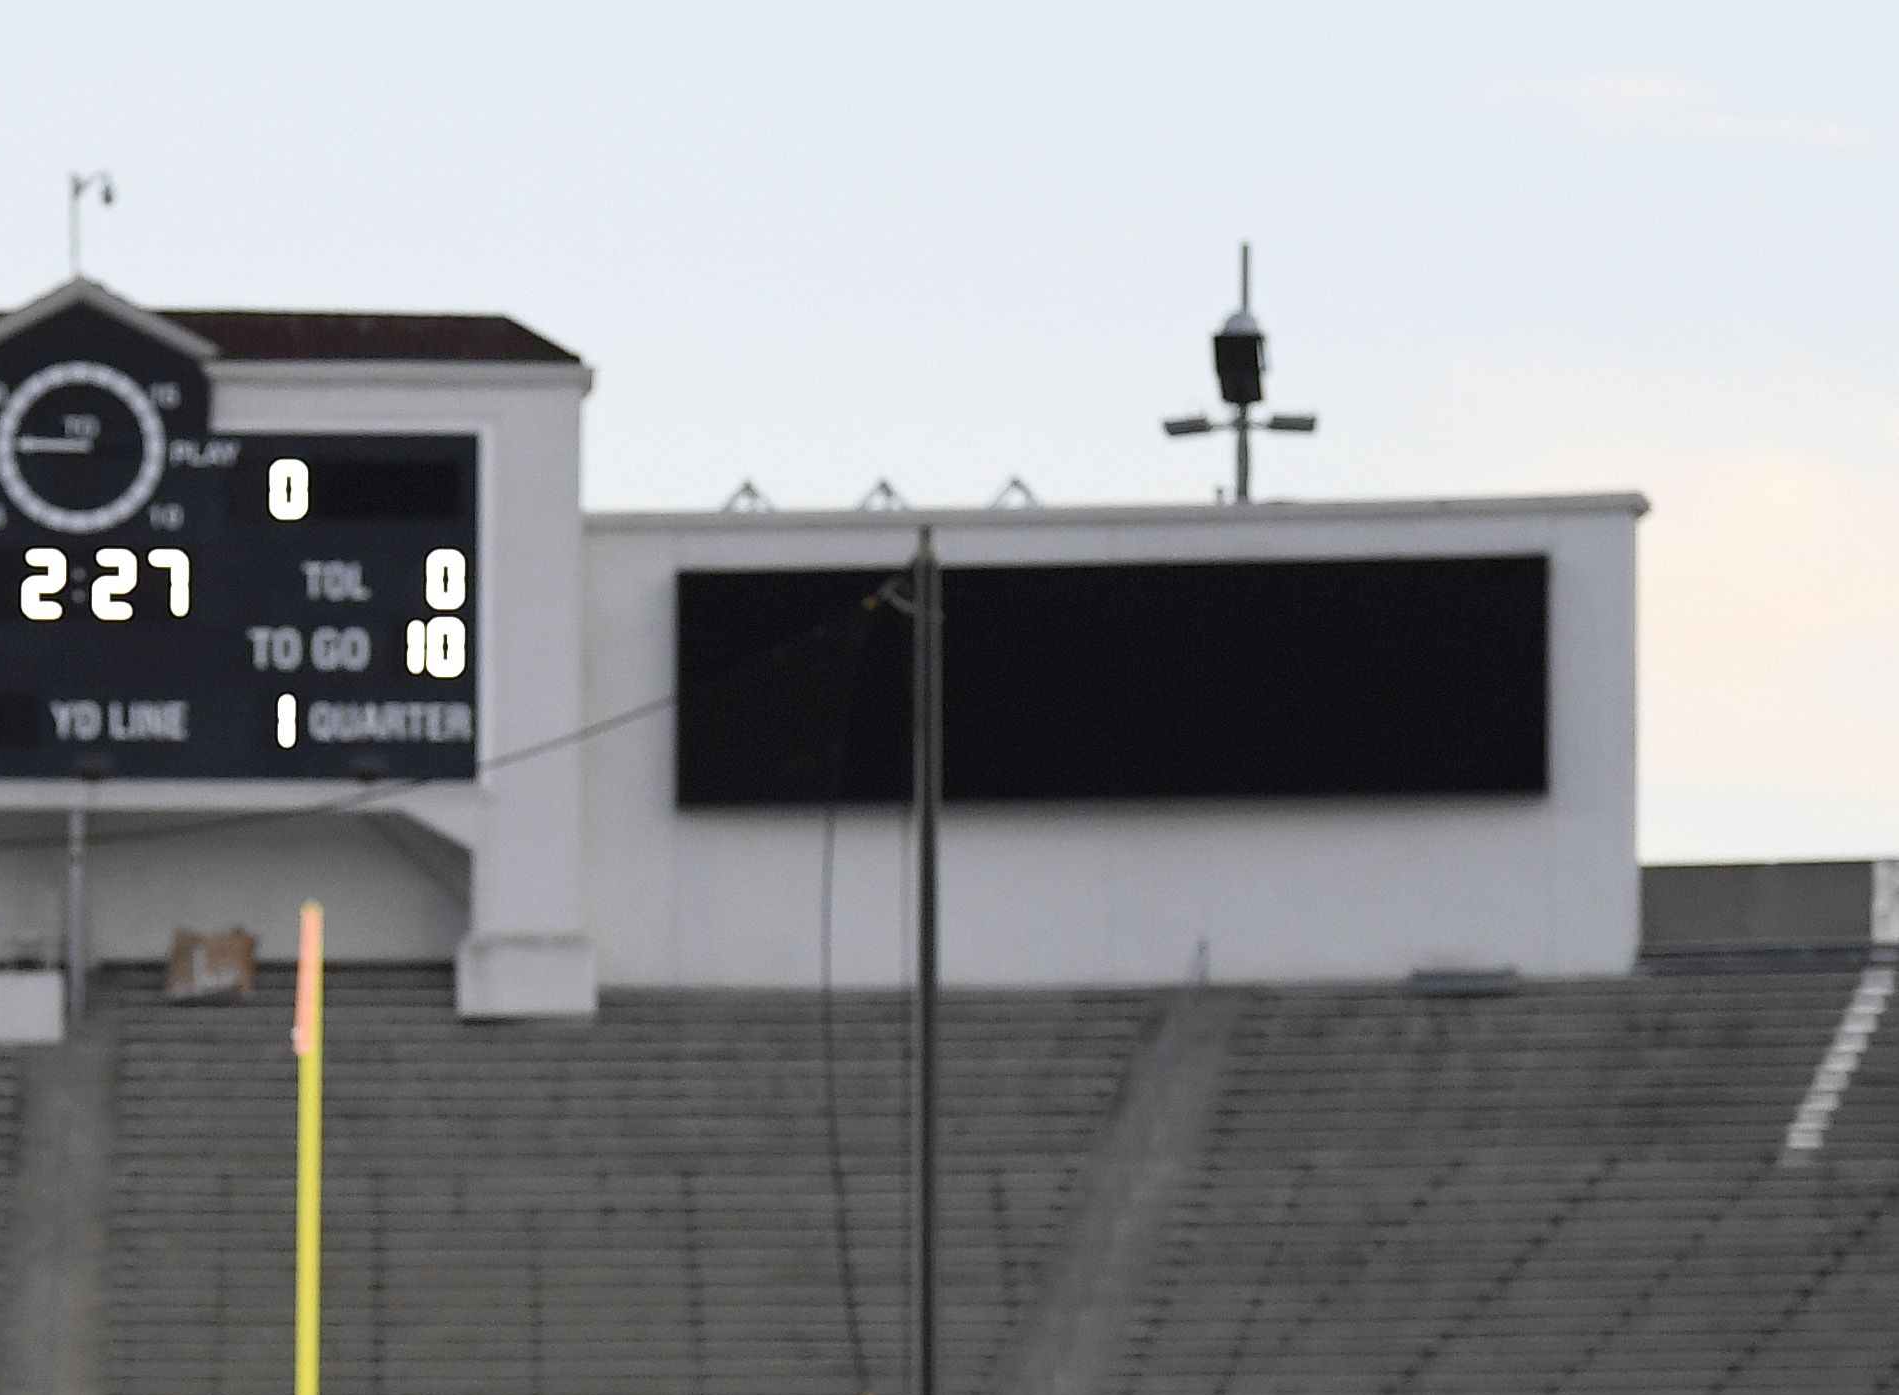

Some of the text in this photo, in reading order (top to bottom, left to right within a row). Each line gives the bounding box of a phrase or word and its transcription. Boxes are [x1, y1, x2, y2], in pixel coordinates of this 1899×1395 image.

[268, 458, 309, 521] 0
[20, 548, 191, 621] 2:27
[302, 560, 372, 602] TOL
[425, 548, 467, 610] 0
[246, 625, 372, 673] TO GO
[406, 616, 467, 678] 10
[49, 700, 190, 742] YD LINE
[277, 693, 297, 749] 1
[307, 701, 472, 743] QUARTER
